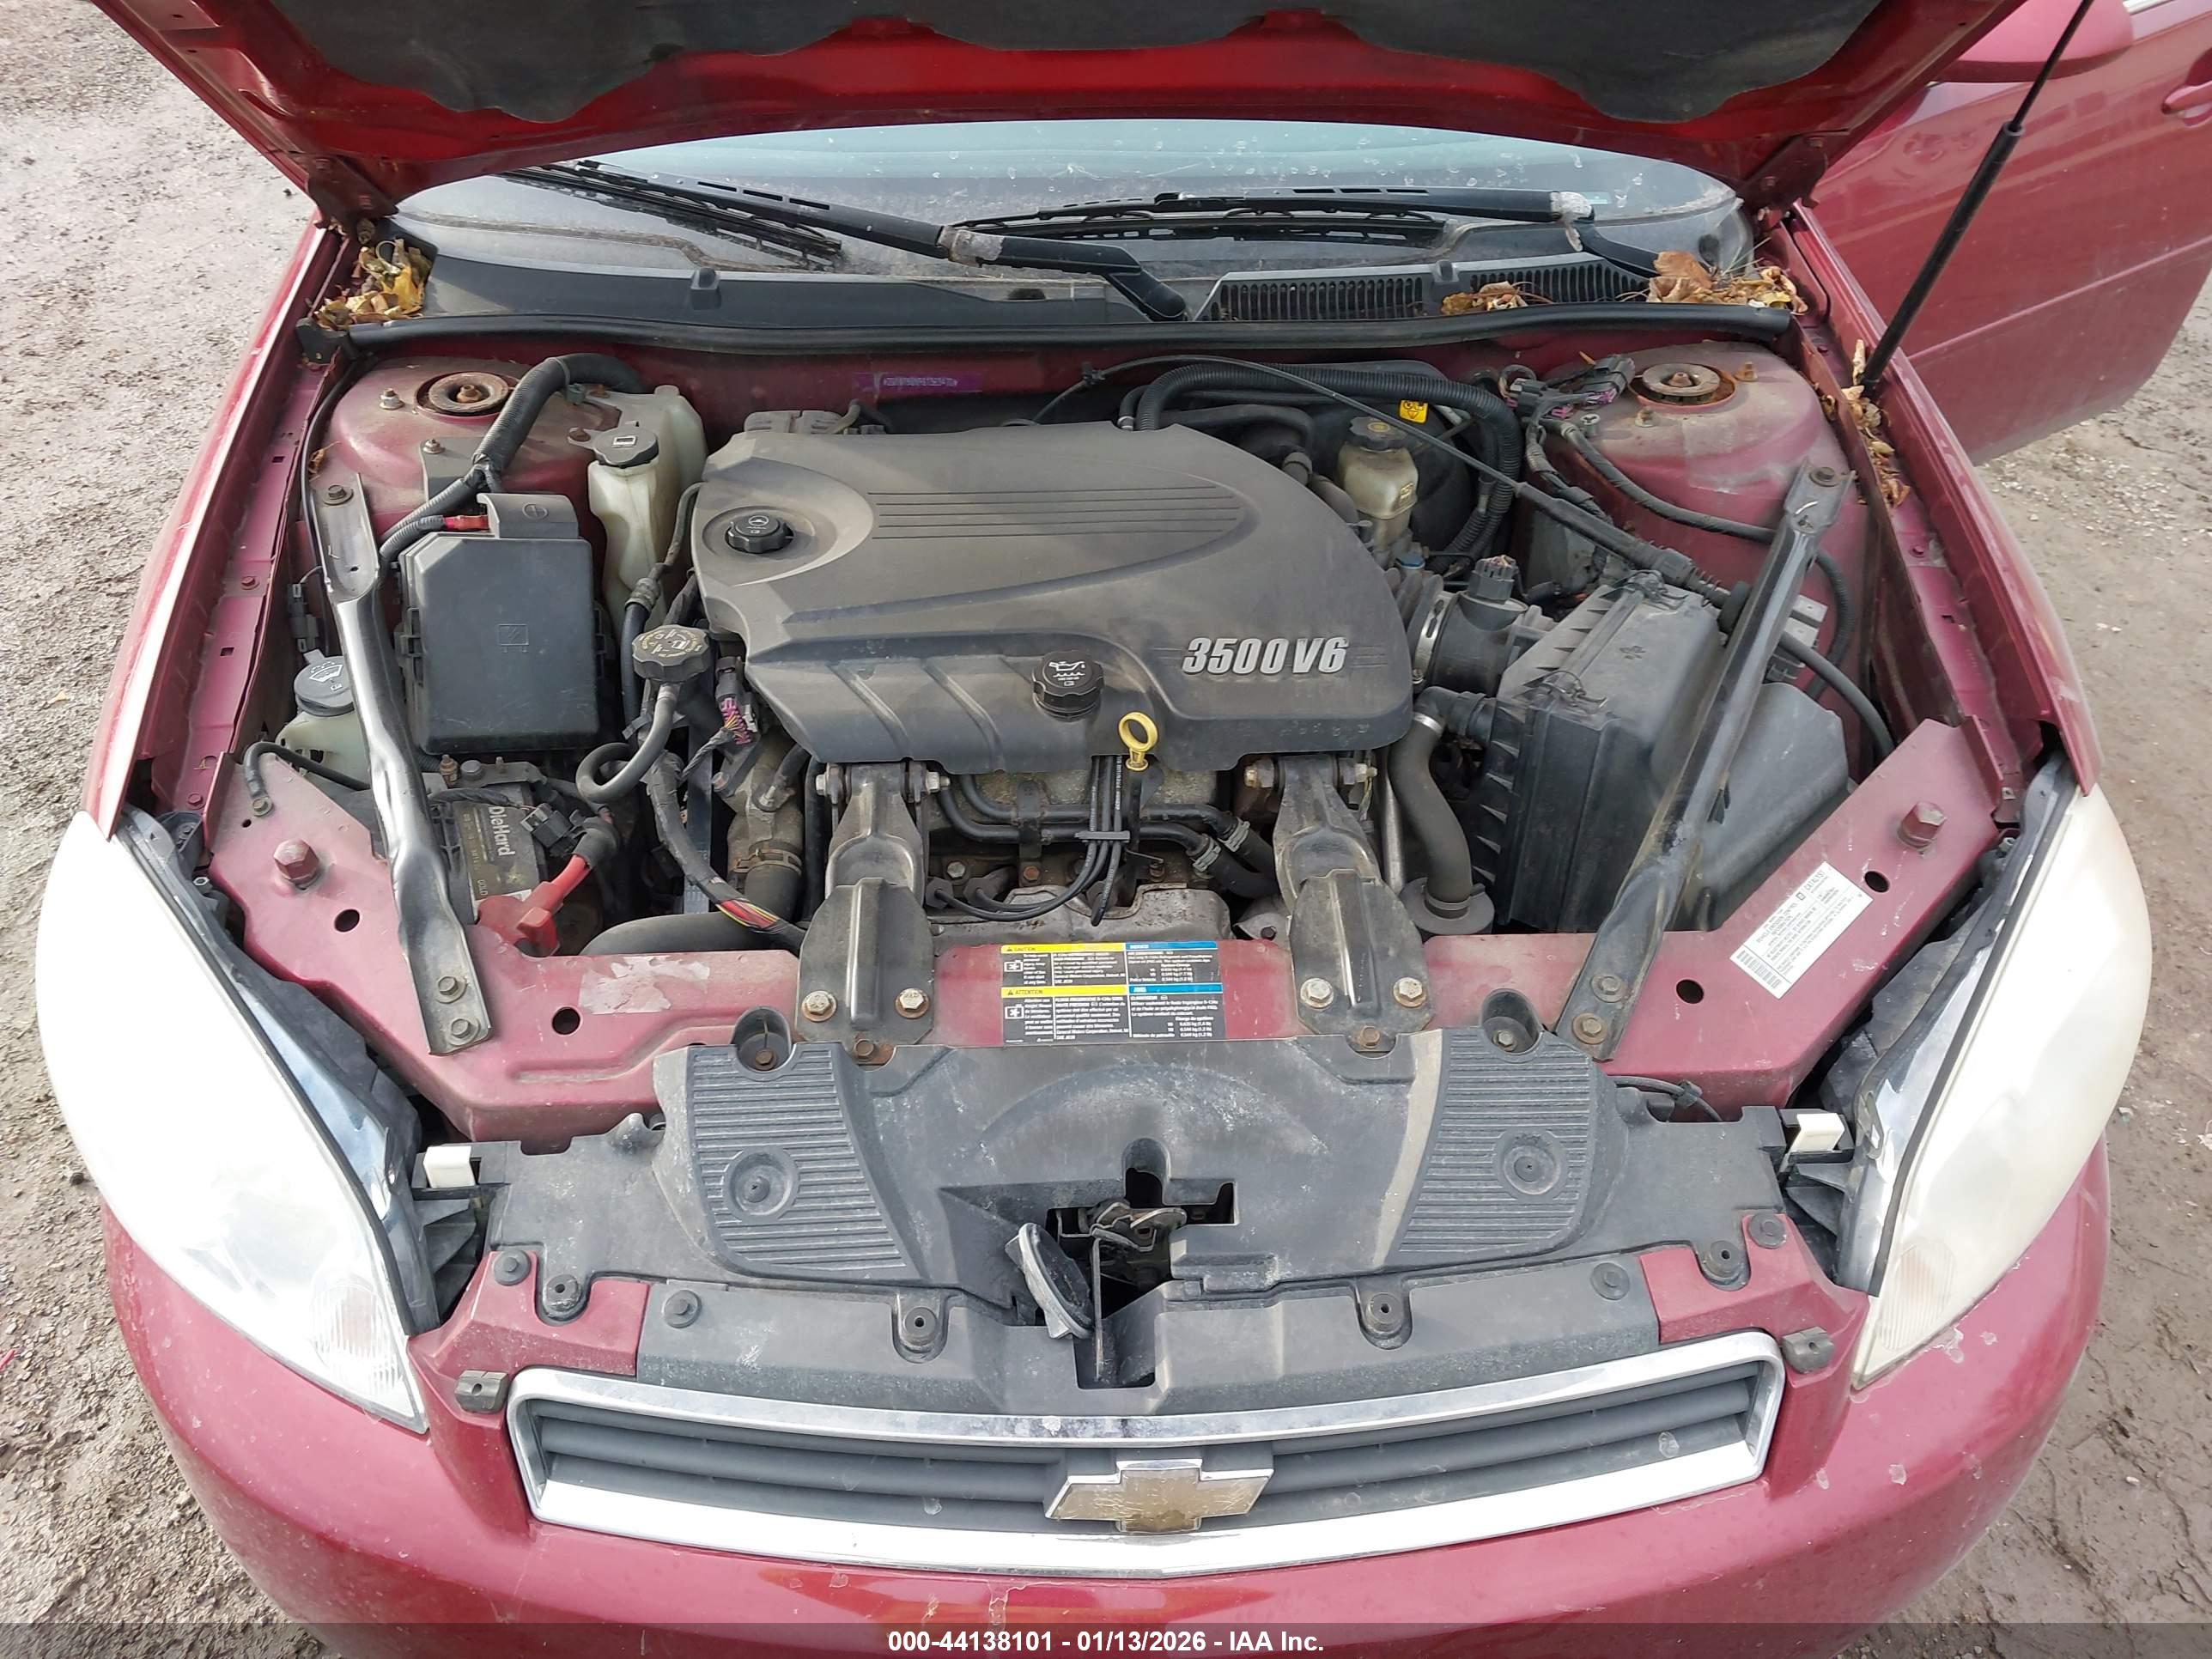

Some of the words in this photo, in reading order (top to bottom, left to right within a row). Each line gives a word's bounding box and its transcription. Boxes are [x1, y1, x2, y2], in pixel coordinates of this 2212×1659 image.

[1182, 636, 1290, 675] 3500
[1291, 636, 1349, 674] V6
[489, 806, 515, 856] DieHard
